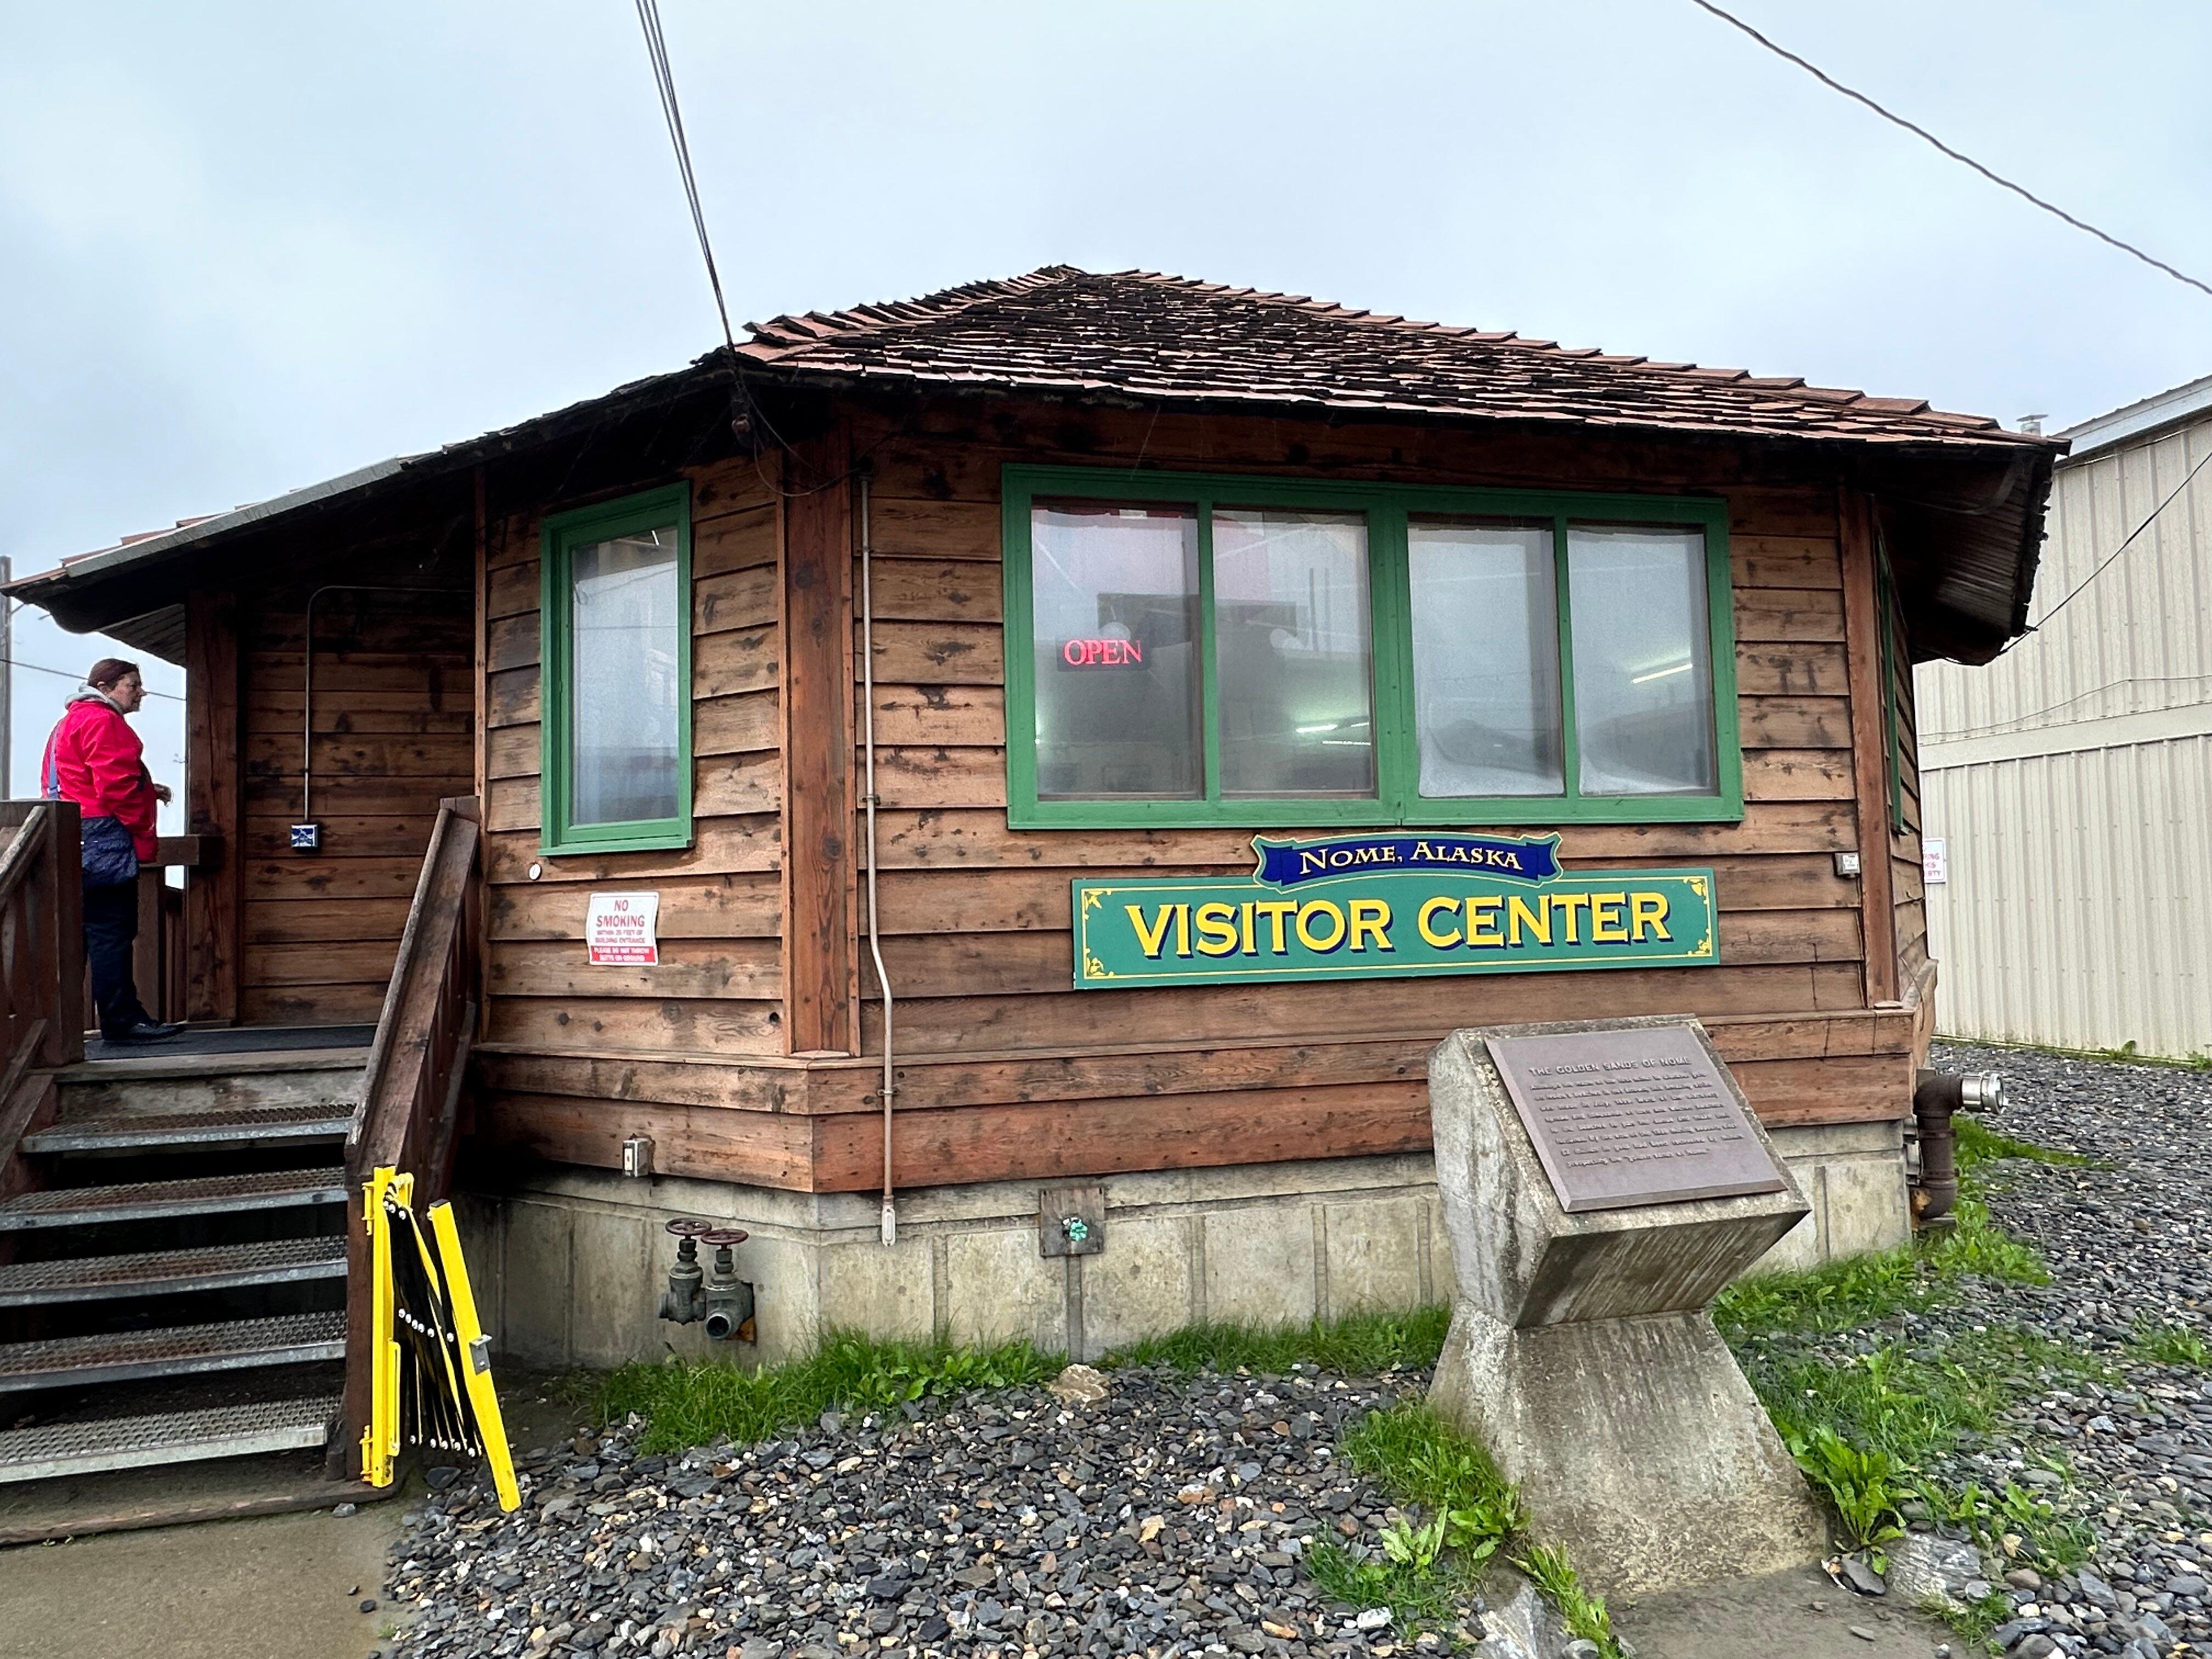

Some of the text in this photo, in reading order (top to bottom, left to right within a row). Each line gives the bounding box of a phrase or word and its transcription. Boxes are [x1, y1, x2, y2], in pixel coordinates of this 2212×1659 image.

[1063, 639, 1142, 665] OPEN
[1410, 841, 1523, 870] ALASKA
[614, 900, 629, 911] NO
[596, 915, 645, 927] SMOKING
[1124, 891, 1673, 959] VISITOR CENTER
[1529, 1067, 1551, 1076] THE
[1556, 1063, 1600, 1075] GOLDEN
[1602, 1060, 1638, 1071] SANDS
[1641, 1058, 1656, 1068] OF
